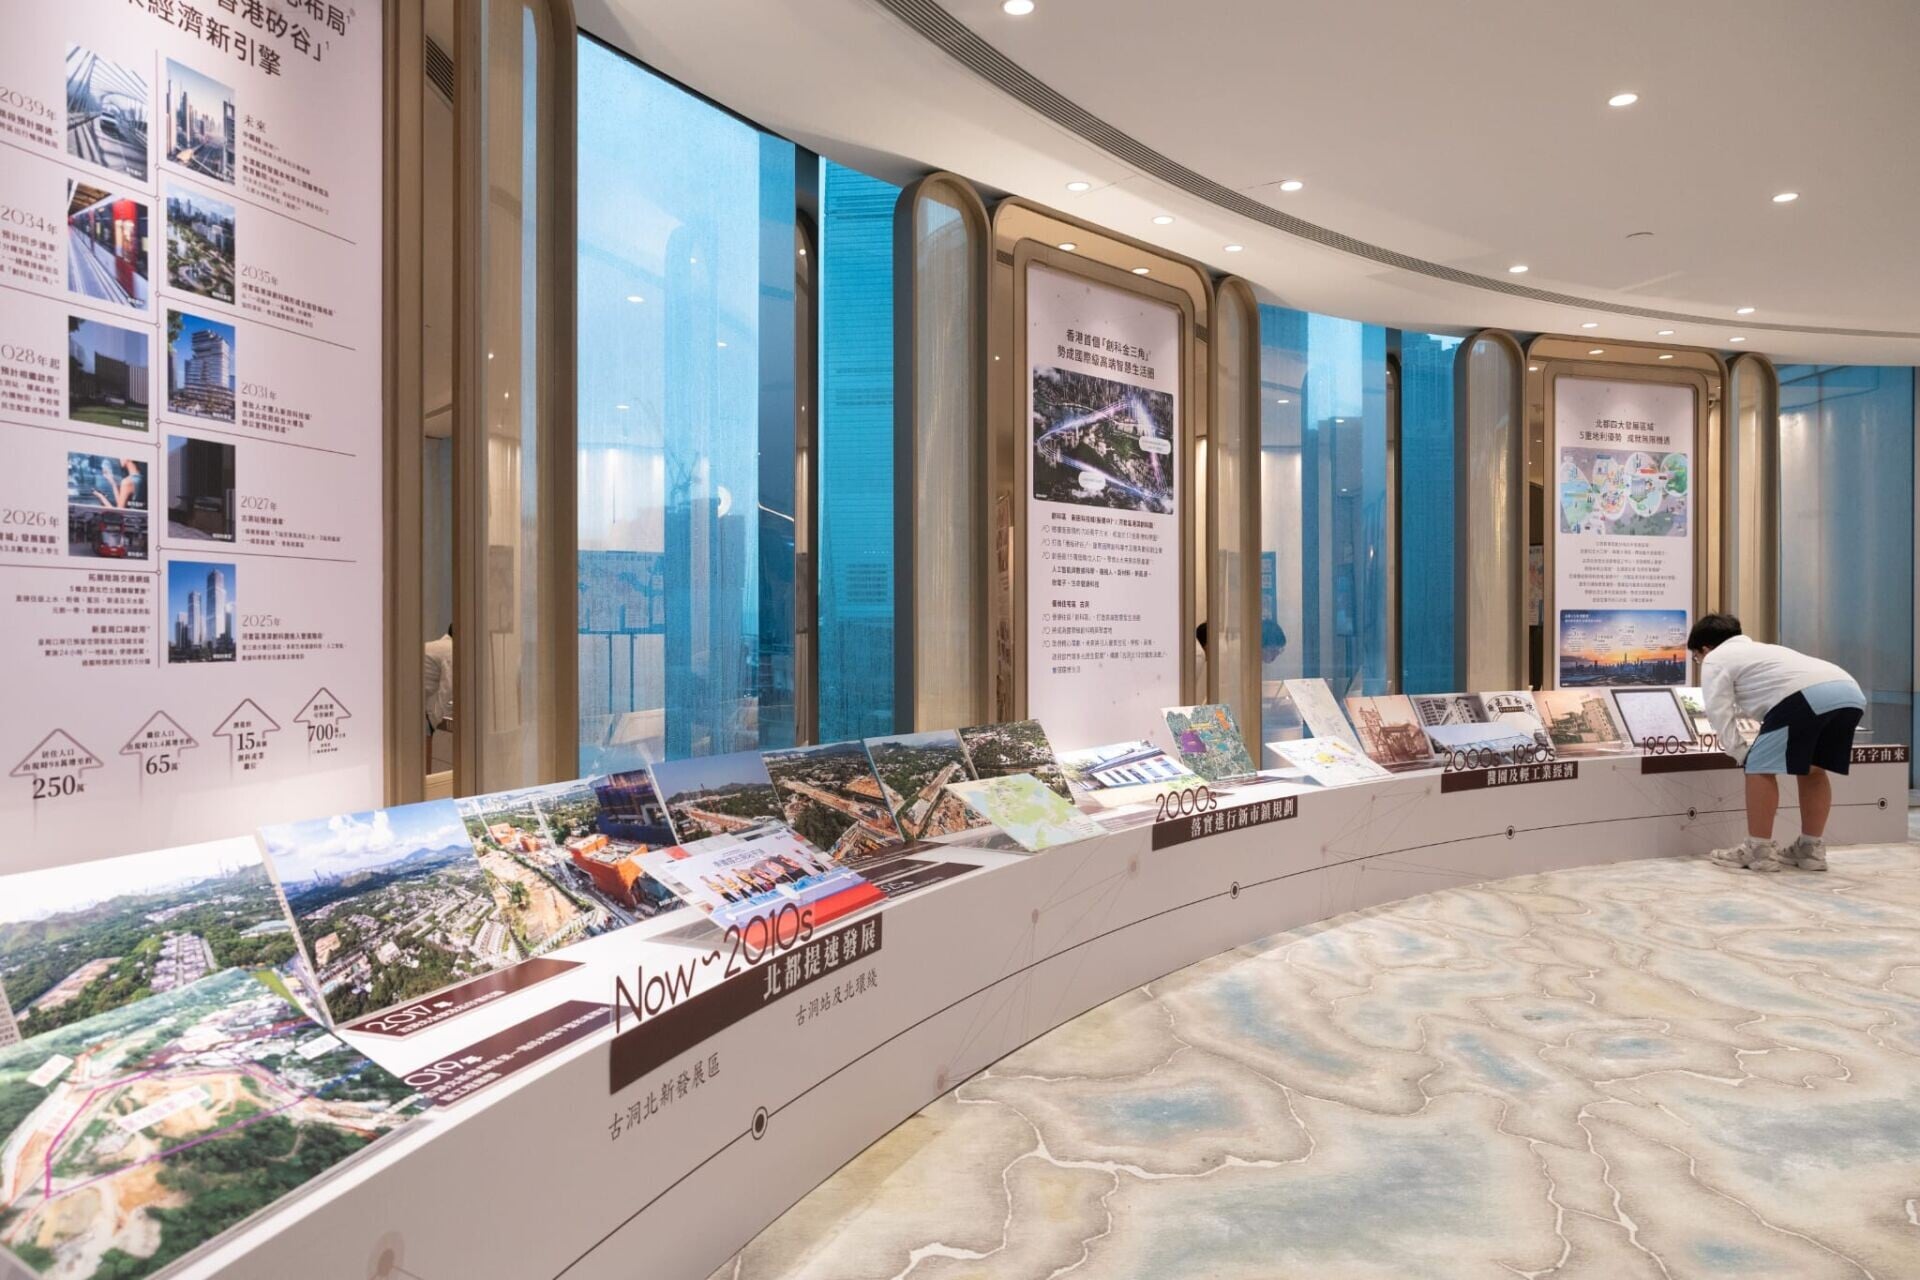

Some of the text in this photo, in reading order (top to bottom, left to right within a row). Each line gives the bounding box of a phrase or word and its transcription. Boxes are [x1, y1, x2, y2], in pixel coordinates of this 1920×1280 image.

[128, 0, 281, 77] 經濟新引擎
[3, 508, 60, 528] 2026年
[1850, 747, 1905, 763] 名字由來
[1155, 785, 1218, 823] 2000s
[763, 921, 877, 1001] 北都提速發展
[403, 1055, 484, 1092] 019年
[608, 1051, 722, 1142] 古洞北新發展區
